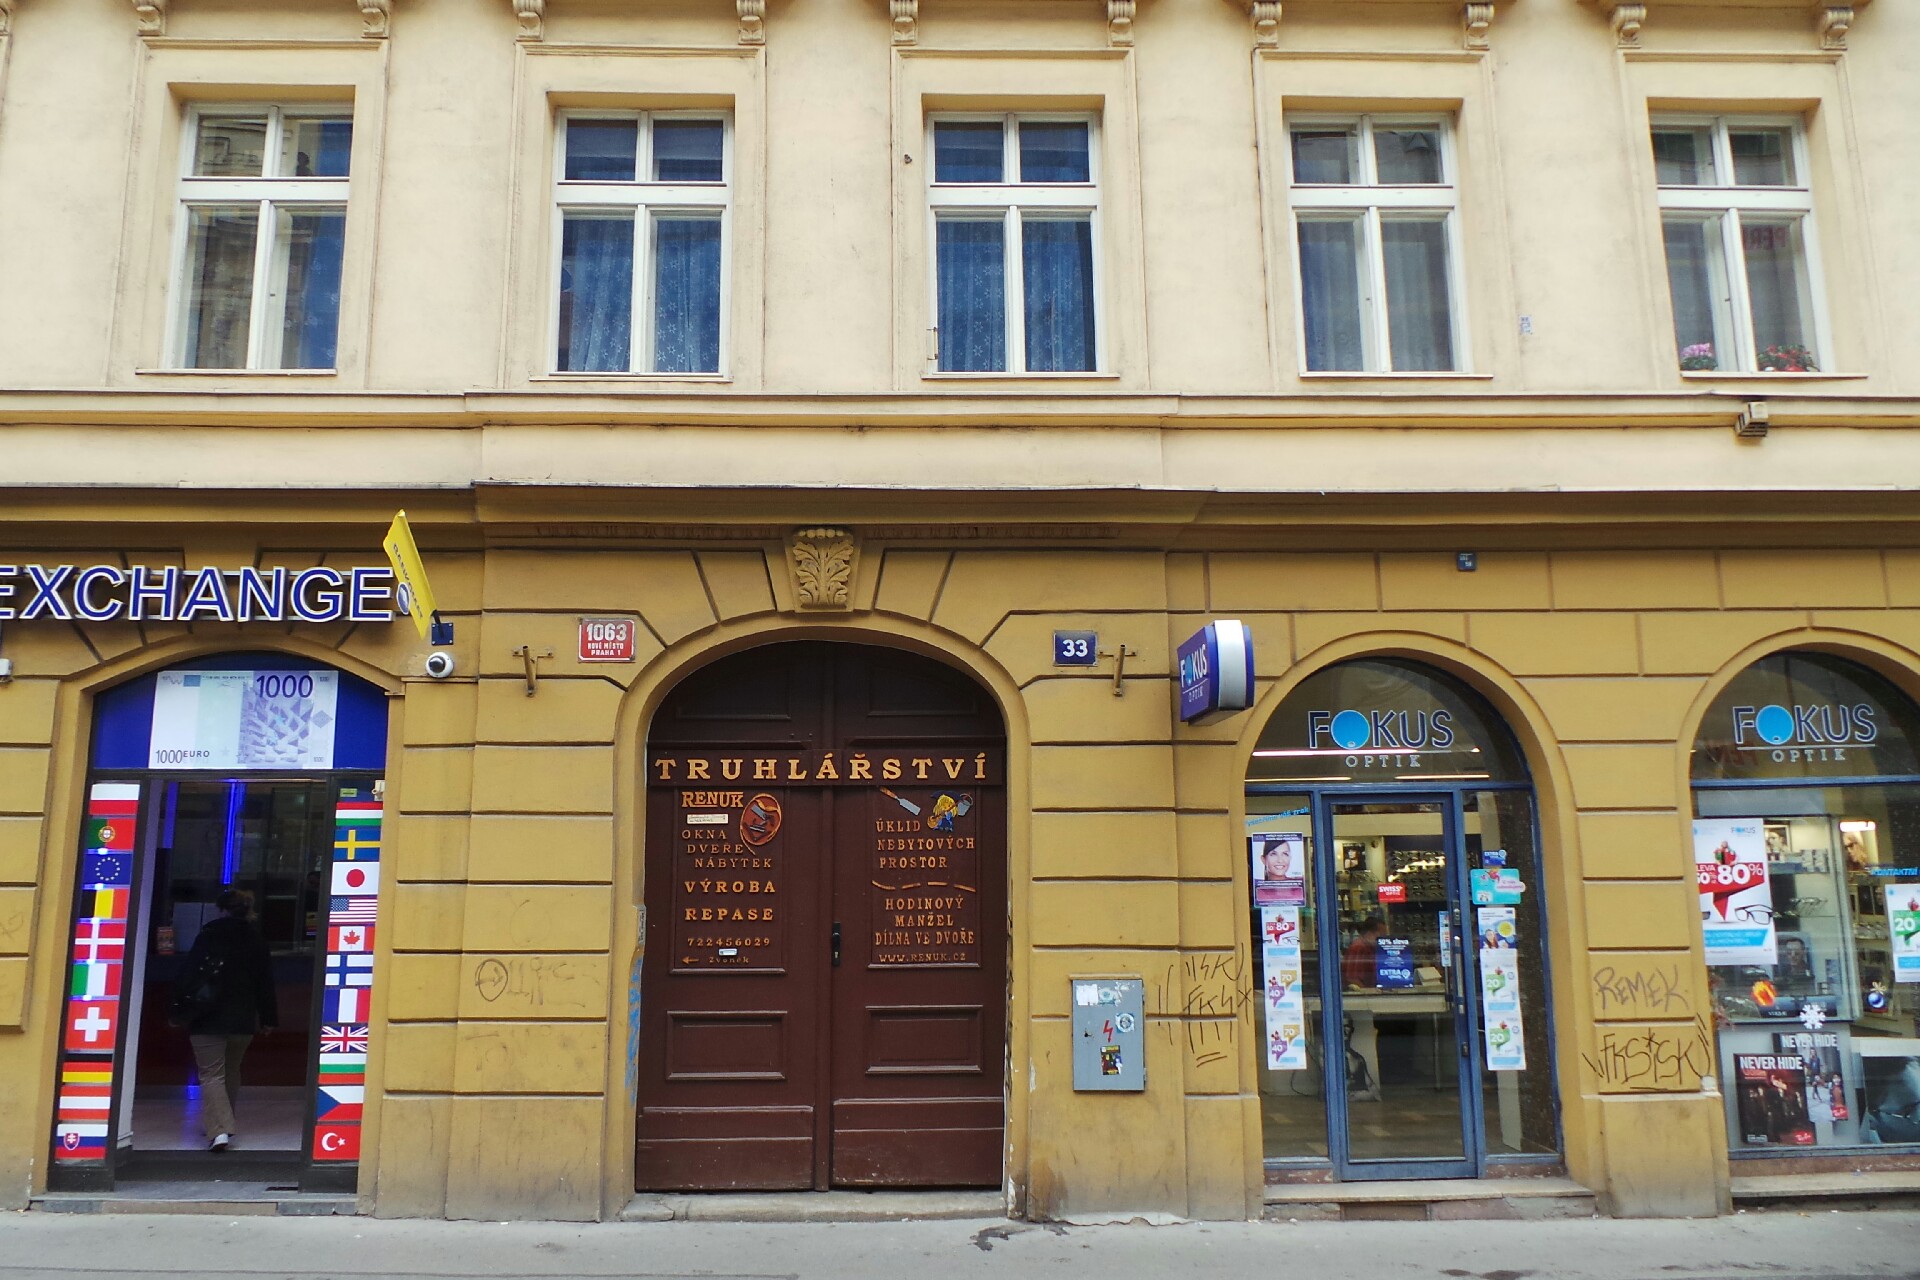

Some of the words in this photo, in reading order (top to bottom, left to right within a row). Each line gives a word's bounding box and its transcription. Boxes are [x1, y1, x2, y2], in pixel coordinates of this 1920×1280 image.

[586, 623, 627, 641] 1063
[1062, 639, 1088, 657] 33
[256, 675, 313, 698] 1000
[1308, 709, 1454, 750] FOKUS
[1733, 704, 1877, 745] FOKUS
[156, 750, 183, 764] 1000
[183, 750, 210, 758] EURO
[1345, 755, 1421, 768] OPTIK
[1772, 749, 1846, 763] OPTIK
[655, 752, 987, 780] TRUHLÁŘSTVÍ
[682, 791, 744, 808] RENUK
[876, 818, 920, 832] ÚKLID
[682, 829, 727, 839] OKNA
[687, 842, 744, 854] DVEŘE
[877, 835, 975, 850] NEBYTOVÝCH
[695, 857, 772, 868] NÁBYTEK
[880, 857, 948, 869] PROSTOR
[684, 878, 776, 893] VÝROBA
[885, 895, 963, 910] HODINOVÝ
[685, 908, 774, 921] REPASE
[894, 912, 954, 927] MANŽEL
[687, 937, 770, 947] 722456029
[875, 929, 910, 946] DÍLNA
[916, 932, 931, 945] VE
[936, 927, 974, 945] DVOŘE
[1781, 1034, 1813, 1048] NEVER
[1813, 1034, 1838, 1047] HIDE
[1740, 1056, 1776, 1069] NEVER
[1777, 1056, 1803, 1069] HIDE
